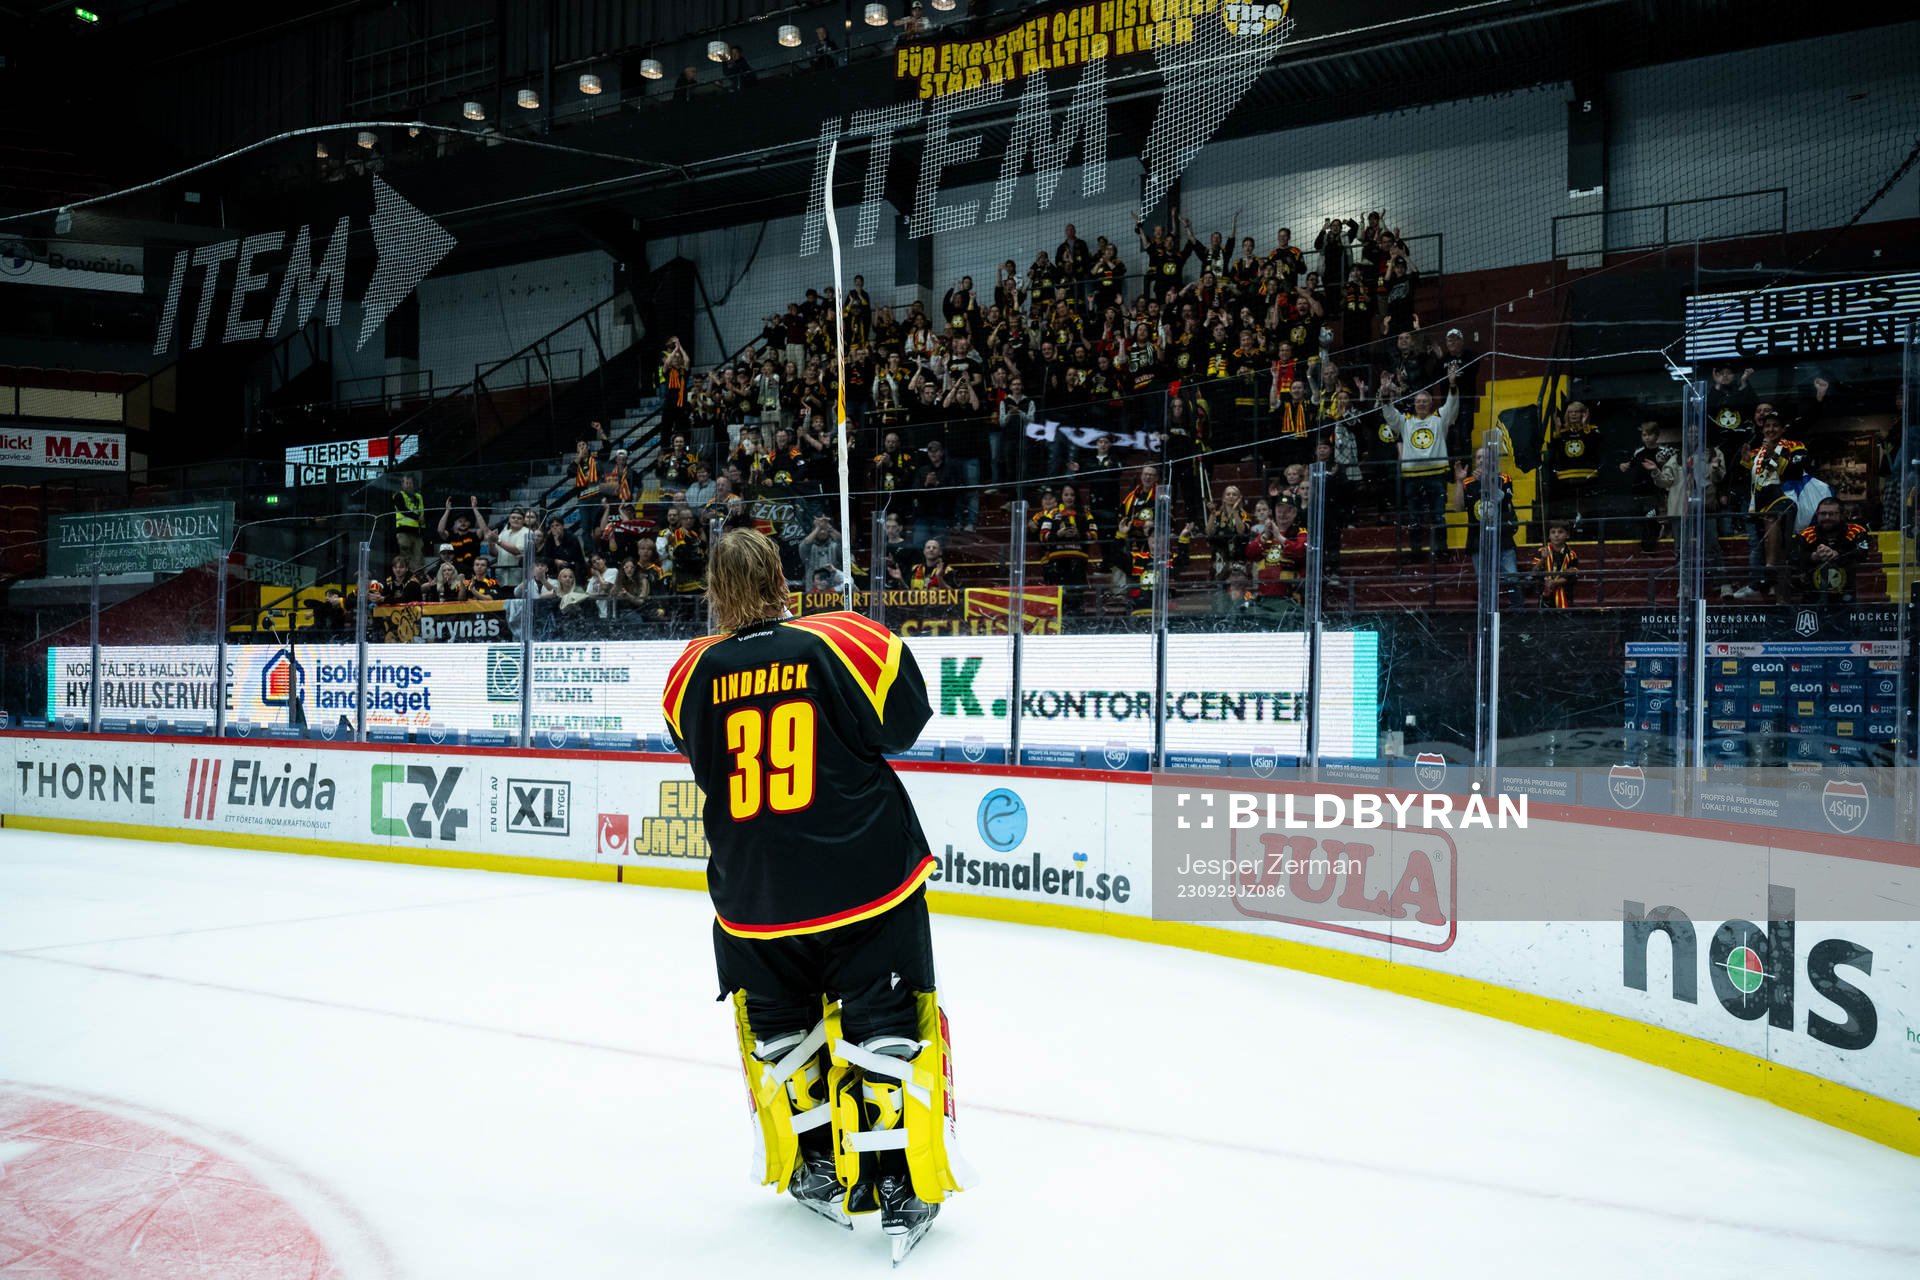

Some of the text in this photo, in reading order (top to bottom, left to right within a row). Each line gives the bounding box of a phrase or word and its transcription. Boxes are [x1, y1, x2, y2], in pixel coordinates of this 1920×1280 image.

[1226, 4, 1282, 21] TIFO
[898, 46, 936, 78] FÖR
[940, 17, 1046, 72] EMBLEMET
[1053, 5, 1093, 43] OCH
[919, 64, 983, 99] STÅR
[1021, 34, 1107, 77] ALLTID
[800, 41, 1107, 257] ITEM
[152, 216, 350, 356] ITEM
[45, 436, 119, 460] MAXI
[302, 441, 360, 464] TIERPS
[60, 458, 119, 467] STORMARKNAD
[302, 461, 371, 484] CEENT
[60, 514, 219, 544] TANDHÄLSOVÅRDEN
[420, 614, 500, 641] Brynäs
[66, 661, 234, 677] NORTÄLJE & HALLSTAVS
[66, 681, 234, 710] HYRAULSERVICE
[712, 662, 809, 705] LINDBÄCK
[940, 656, 1007, 717] K.
[726, 699, 817, 822] 39
[1254, 757, 1273, 770] 4Sign
[1419, 766, 1441, 782] 4Sign
[17, 761, 155, 804] THORNE
[227, 759, 337, 811] Elvida
[1532, 779, 1567, 788] PROFILERING
[1543, 788, 1566, 797] SVERIGE
[1613, 781, 1639, 799] 4Sign
[490, 776, 498, 832] EN DEL AV
[511, 786, 564, 828] XL
[1700, 793, 1725, 802] PROFFS
[1736, 796, 1779, 807] PROFILERING
[1701, 803, 1726, 812] LOKALT
[1749, 807, 1778, 817] SVERIGE
[1828, 799, 1861, 821] 4Sign
[225, 814, 236, 823] ETT
[236, 815, 263, 825] FÖRETAG
[284, 819, 331, 829] KRAFTKONSULT
[1238, 832, 1447, 926] JULA
[1623, 883, 1878, 1051] nds
